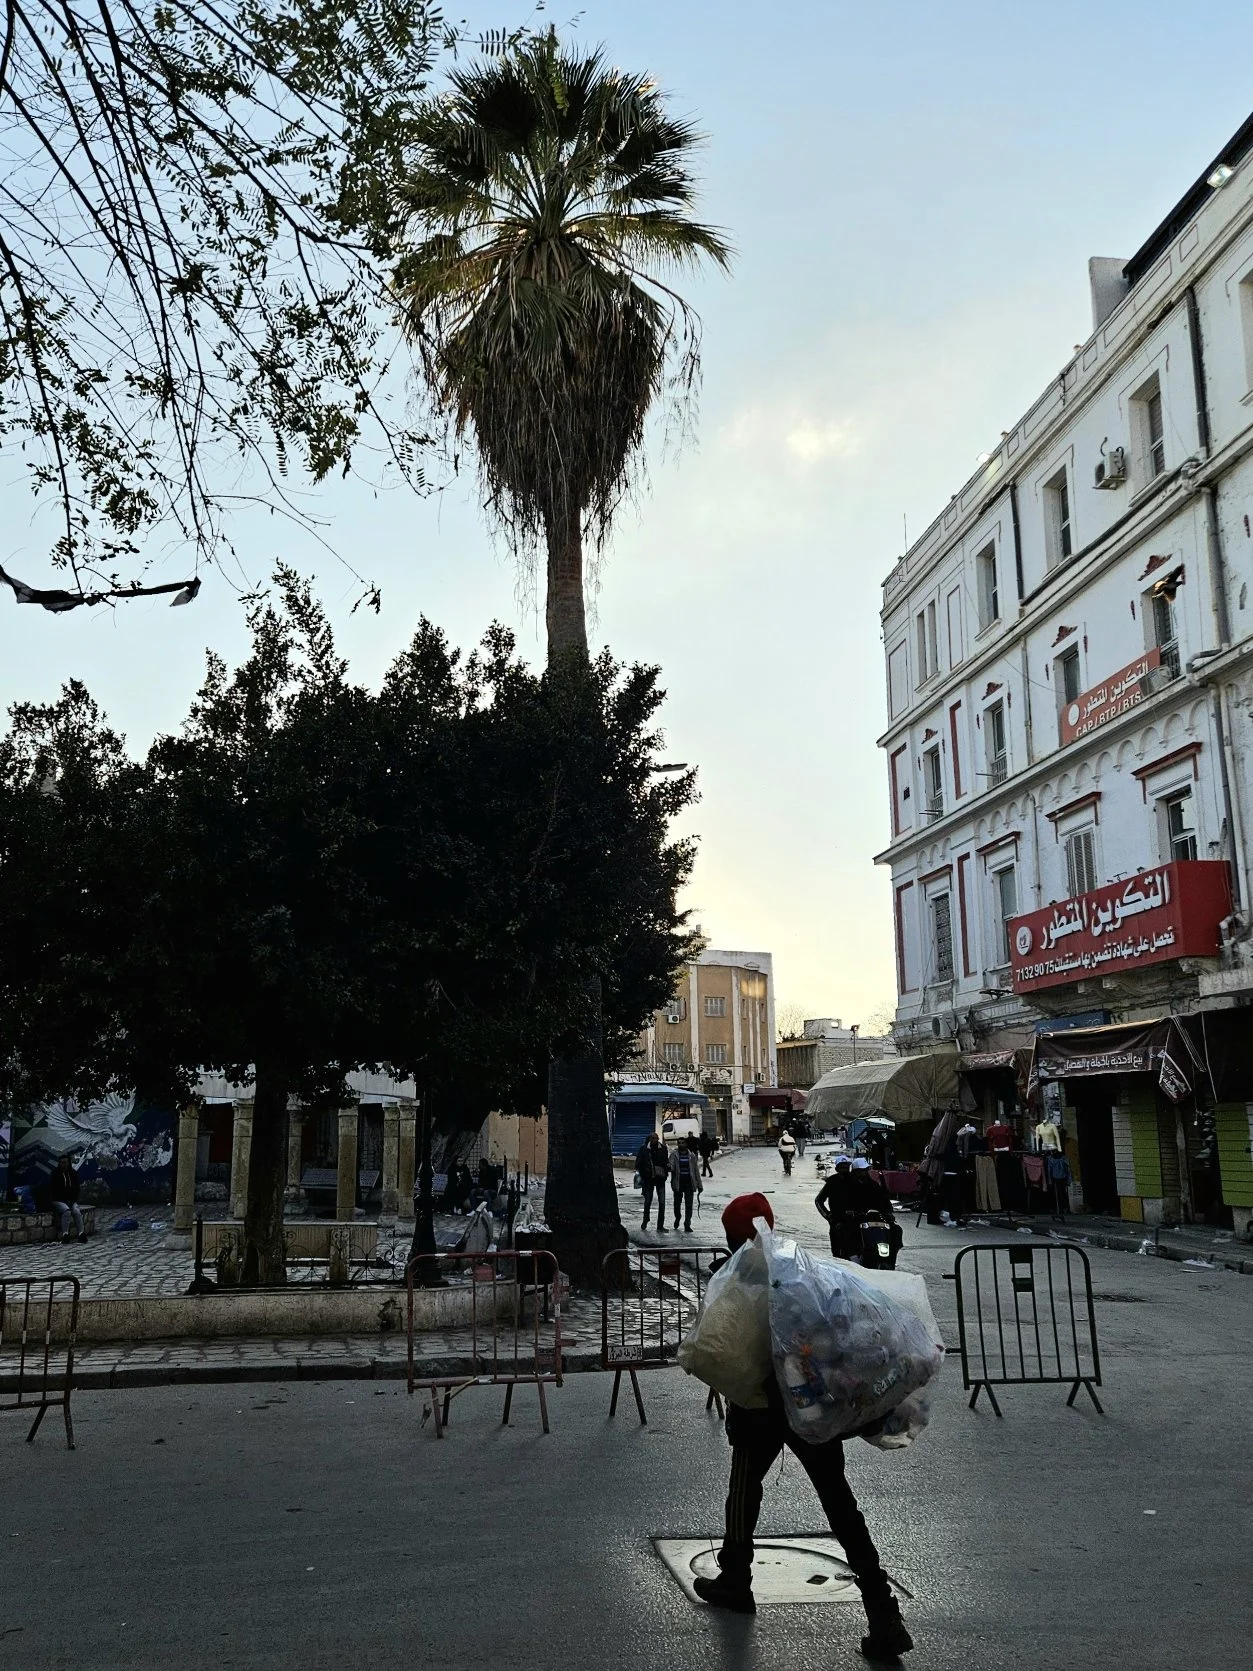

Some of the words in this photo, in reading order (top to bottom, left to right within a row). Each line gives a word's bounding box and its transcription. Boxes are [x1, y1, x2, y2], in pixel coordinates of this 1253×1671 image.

[1110, 660, 1148, 703] التكوين
[1076, 719, 1093, 737] CAP
[1099, 706, 1116, 724] BTP
[1123, 690, 1141, 710] BTS
[1082, 687, 1108, 719] المتطور
[1092, 869, 1170, 937] التكوين
[1040, 897, 1088, 950] المتطور
[1150, 925, 1175, 953] تحصل
[1112, 936, 1133, 960] شهادة
[1133, 935, 1149, 957] على
[1133, 1055, 1143, 1068] بيع
